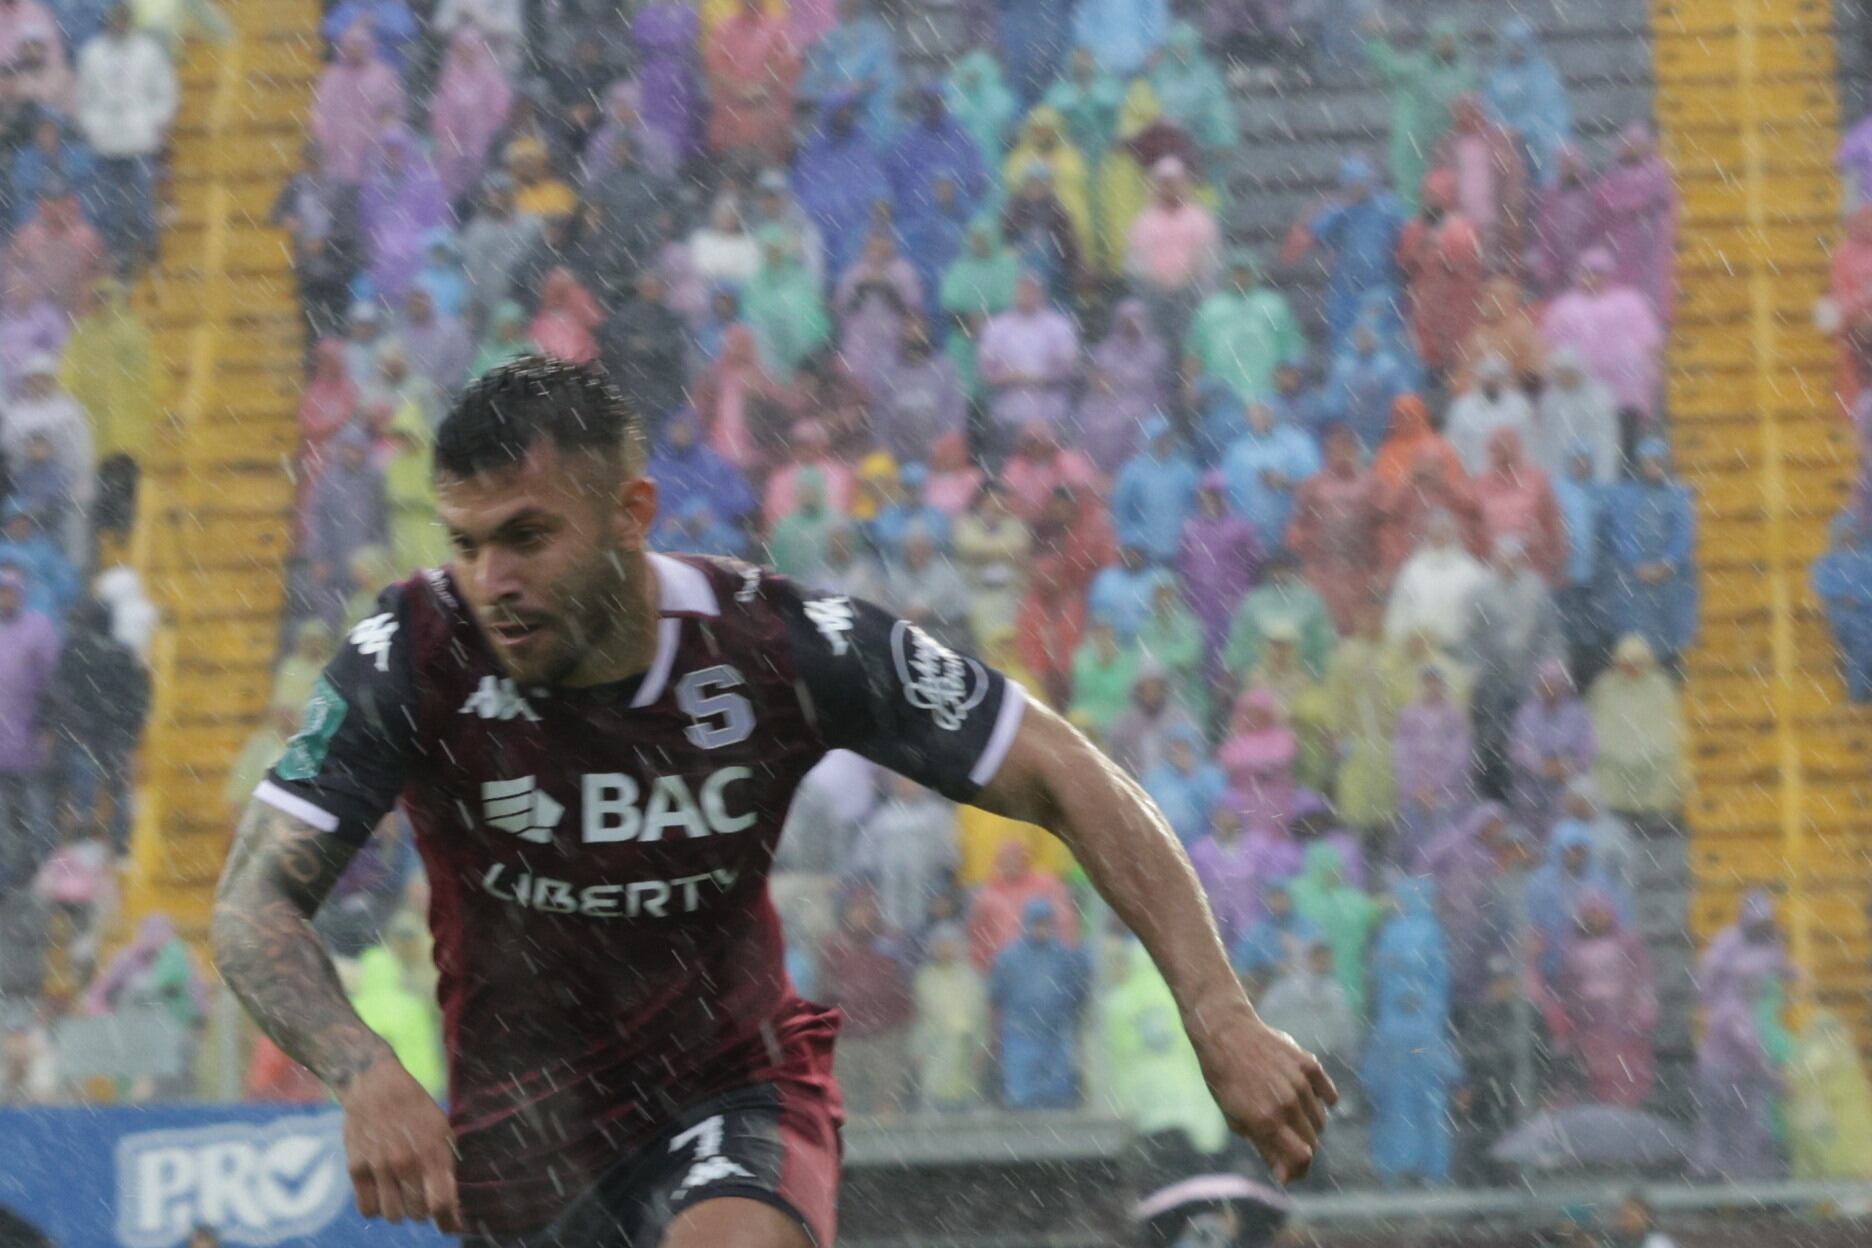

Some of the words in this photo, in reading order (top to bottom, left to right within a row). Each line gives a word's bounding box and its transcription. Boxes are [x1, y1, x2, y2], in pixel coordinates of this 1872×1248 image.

[675, 664, 757, 750] S
[582, 766, 758, 843] BAC
[481, 862, 740, 919] LIBERTY
[668, 1114, 726, 1161] 7
